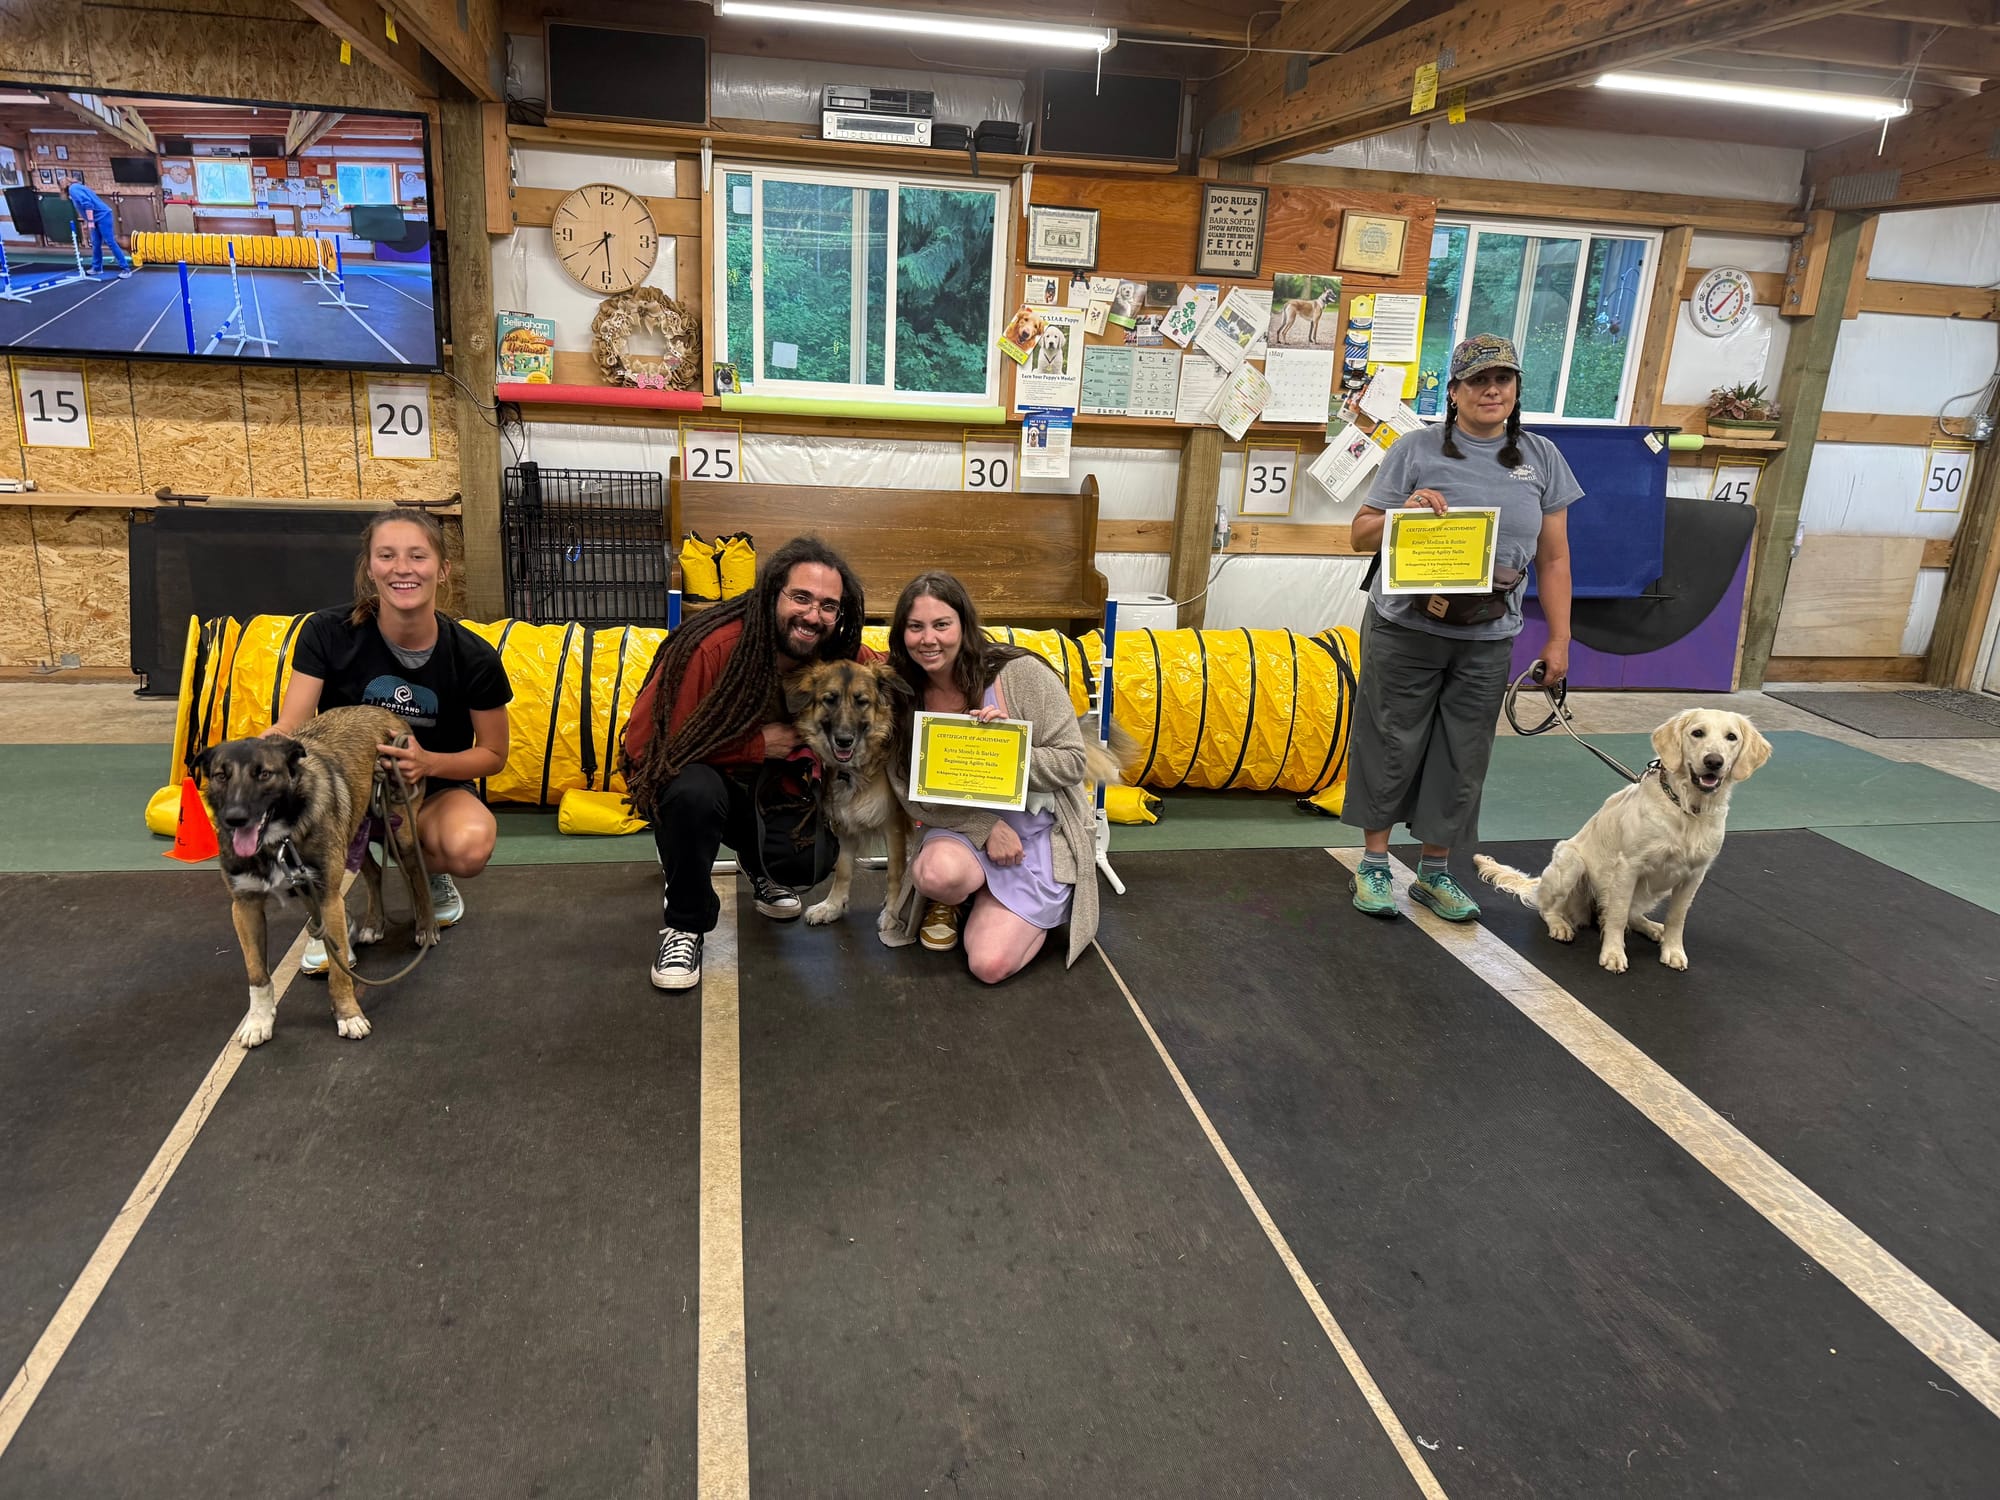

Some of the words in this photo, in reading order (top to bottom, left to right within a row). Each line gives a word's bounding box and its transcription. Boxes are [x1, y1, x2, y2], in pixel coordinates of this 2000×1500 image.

[600, 192, 614, 206] 12
[1210, 196, 1229, 204] DOG
[1230, 196, 1258, 206] RULES
[1230, 218, 1256, 226] SOFTLY
[562, 228, 572, 241] 9
[640, 235, 650, 248] 3
[1207, 239, 1254, 250] FETCH
[602, 271, 612, 284] 6
[503, 317, 550, 330] Bellingham
[30, 390, 78, 423] 15
[377, 403, 423, 436] 20
[692, 448, 733, 478] 25
[969, 458, 1008, 487] 30
[1250, 466, 1287, 494] 35
[1929, 467, 1962, 492] 50
[1714, 482, 1750, 505] 45
[381, 702, 420, 714] PORTLAND
